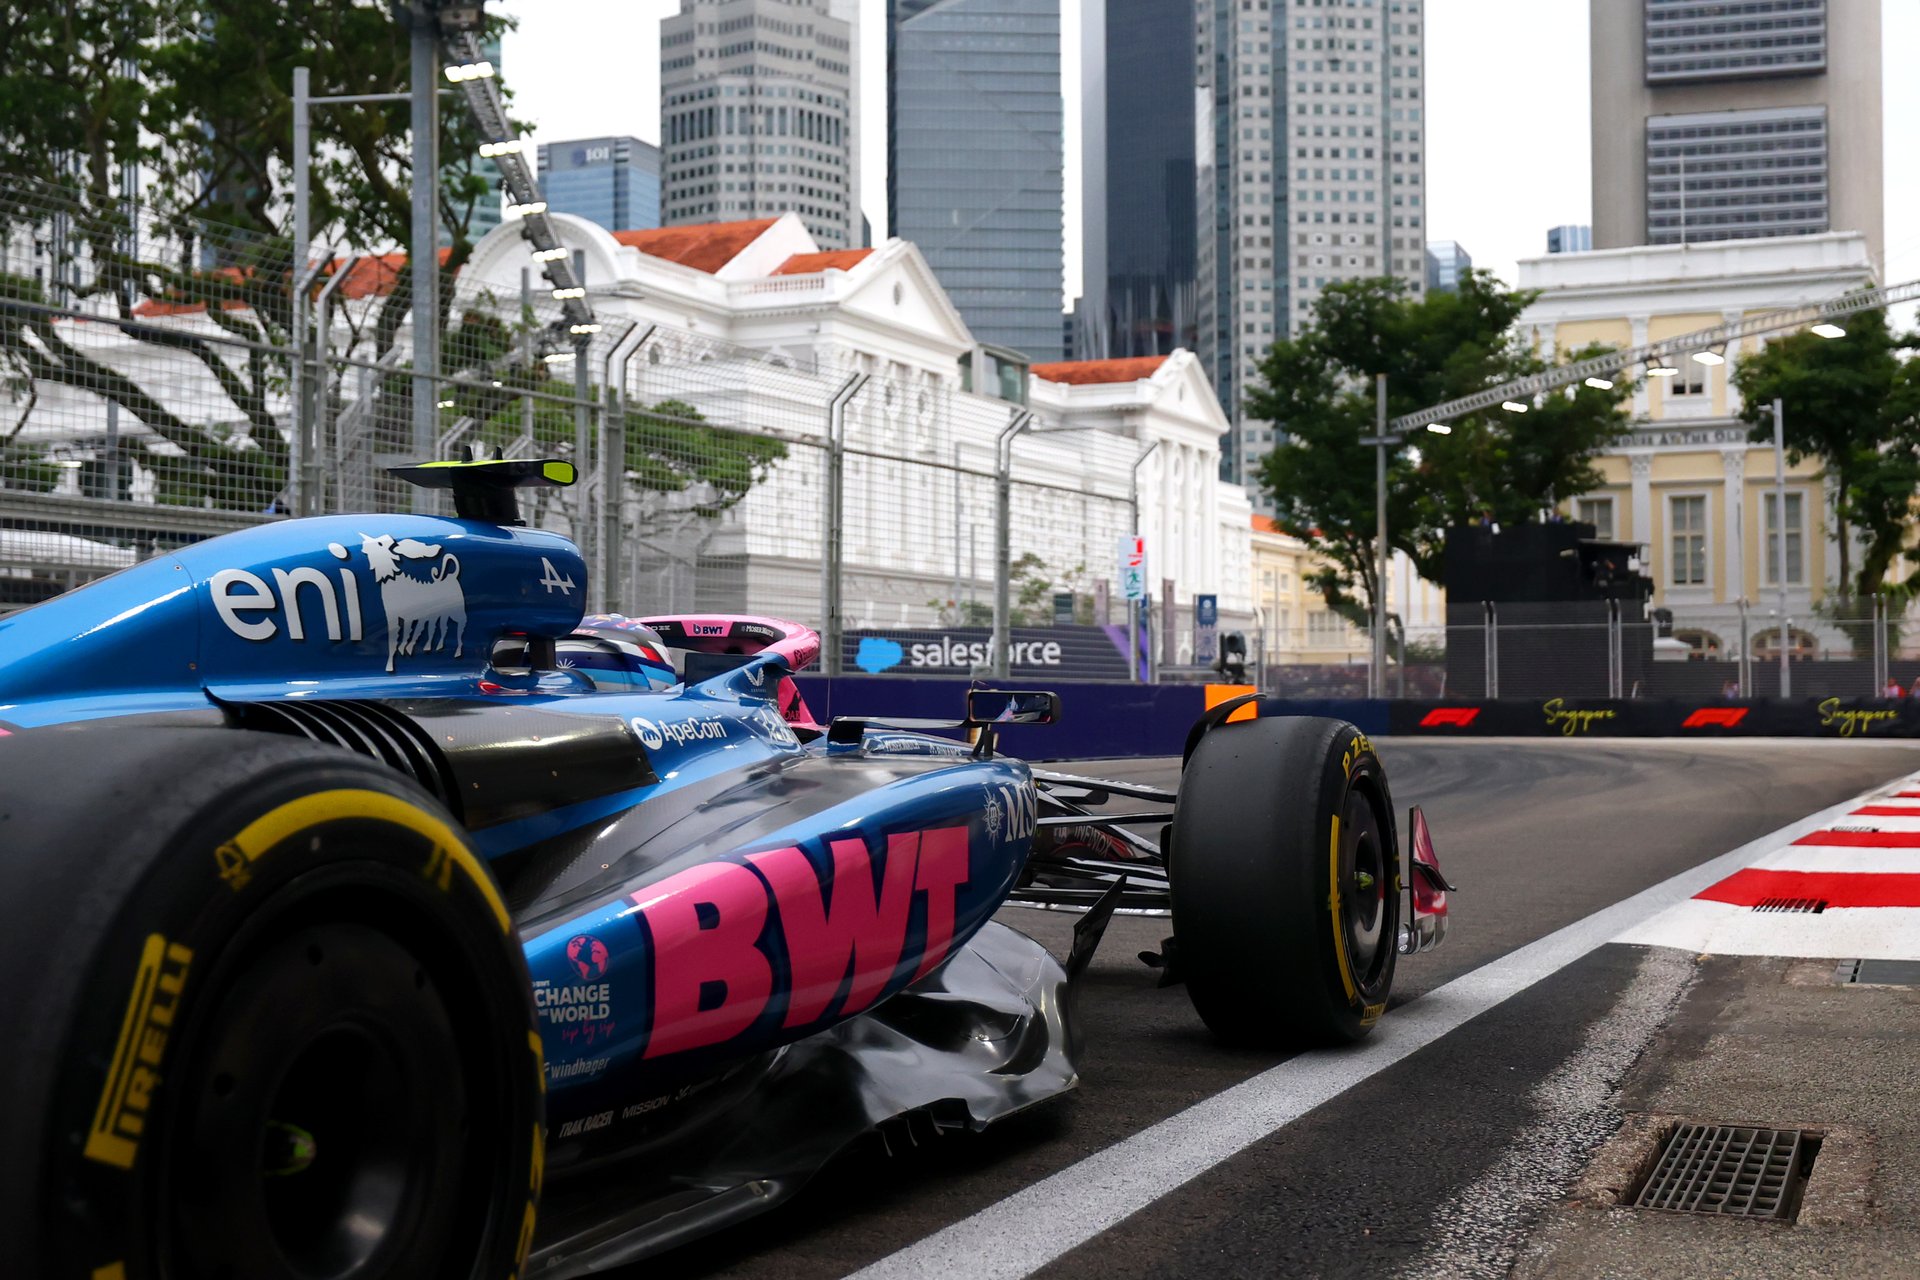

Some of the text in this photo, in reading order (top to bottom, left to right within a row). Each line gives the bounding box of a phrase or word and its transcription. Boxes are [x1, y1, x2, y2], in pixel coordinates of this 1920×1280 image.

[210, 542, 363, 641] eni
[702, 625, 723, 635] BWT
[1542, 697, 1616, 736] Singapore
[1818, 696, 1898, 736] Singapore
[658, 717, 727, 747] ApeCoin
[630, 825, 970, 1060] BWT
[533, 983, 611, 1007] CHANGE
[550, 1003, 611, 1024] WORLD
[84, 932, 195, 1170] PIRELLI
[551, 1057, 611, 1079] windhager
[622, 1094, 671, 1119] MISSION
